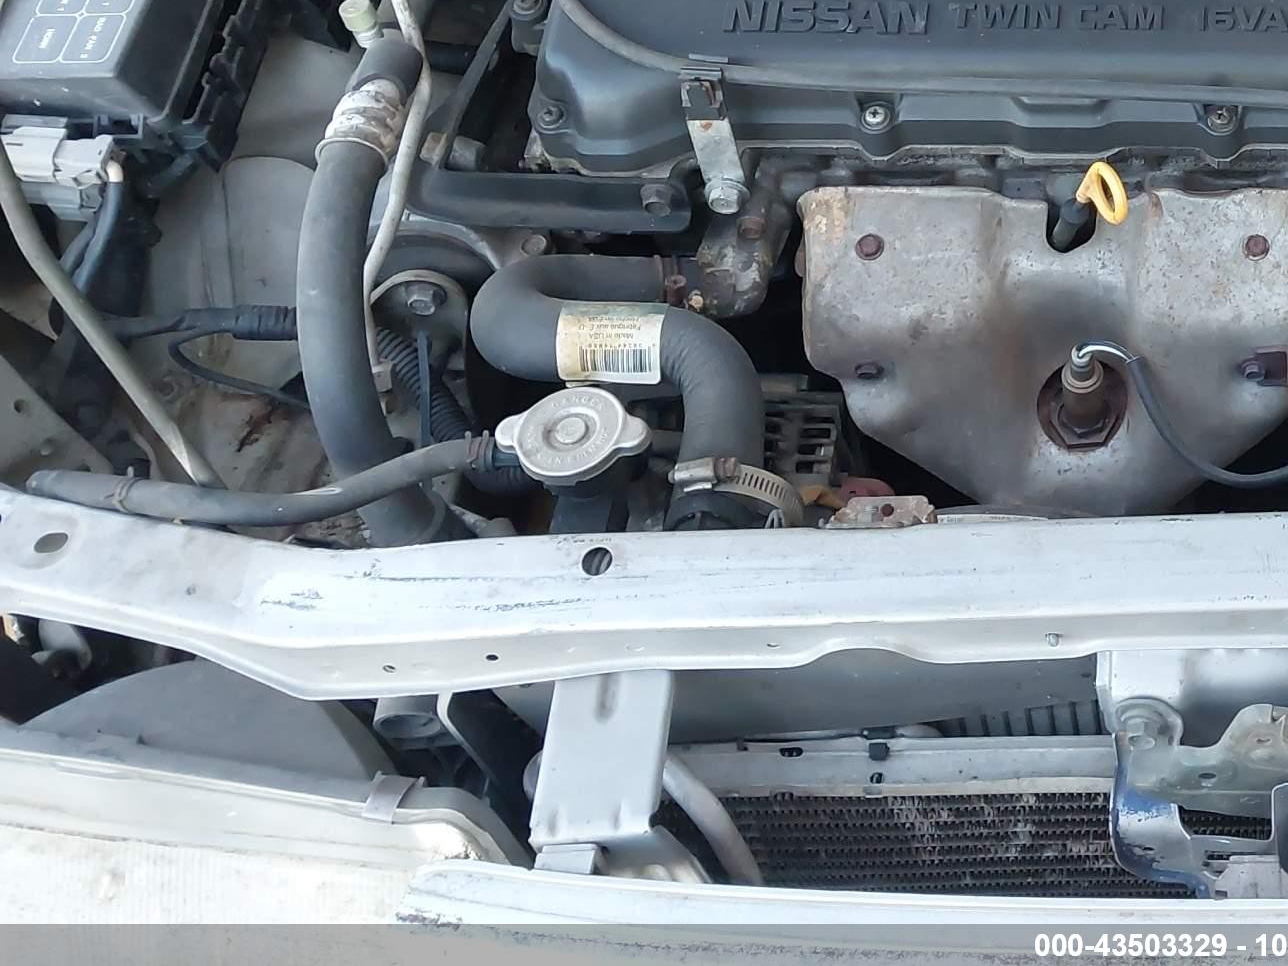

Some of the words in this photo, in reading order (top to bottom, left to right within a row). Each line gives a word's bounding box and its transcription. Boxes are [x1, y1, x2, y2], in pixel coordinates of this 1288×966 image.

[94, 17, 106, 32] RAD
[723, 0, 930, 35] NISSAN
[949, 2, 1061, 30] TWIN
[1077, 4, 1164, 31] CAM
[84, 35, 97, 50] FAN
